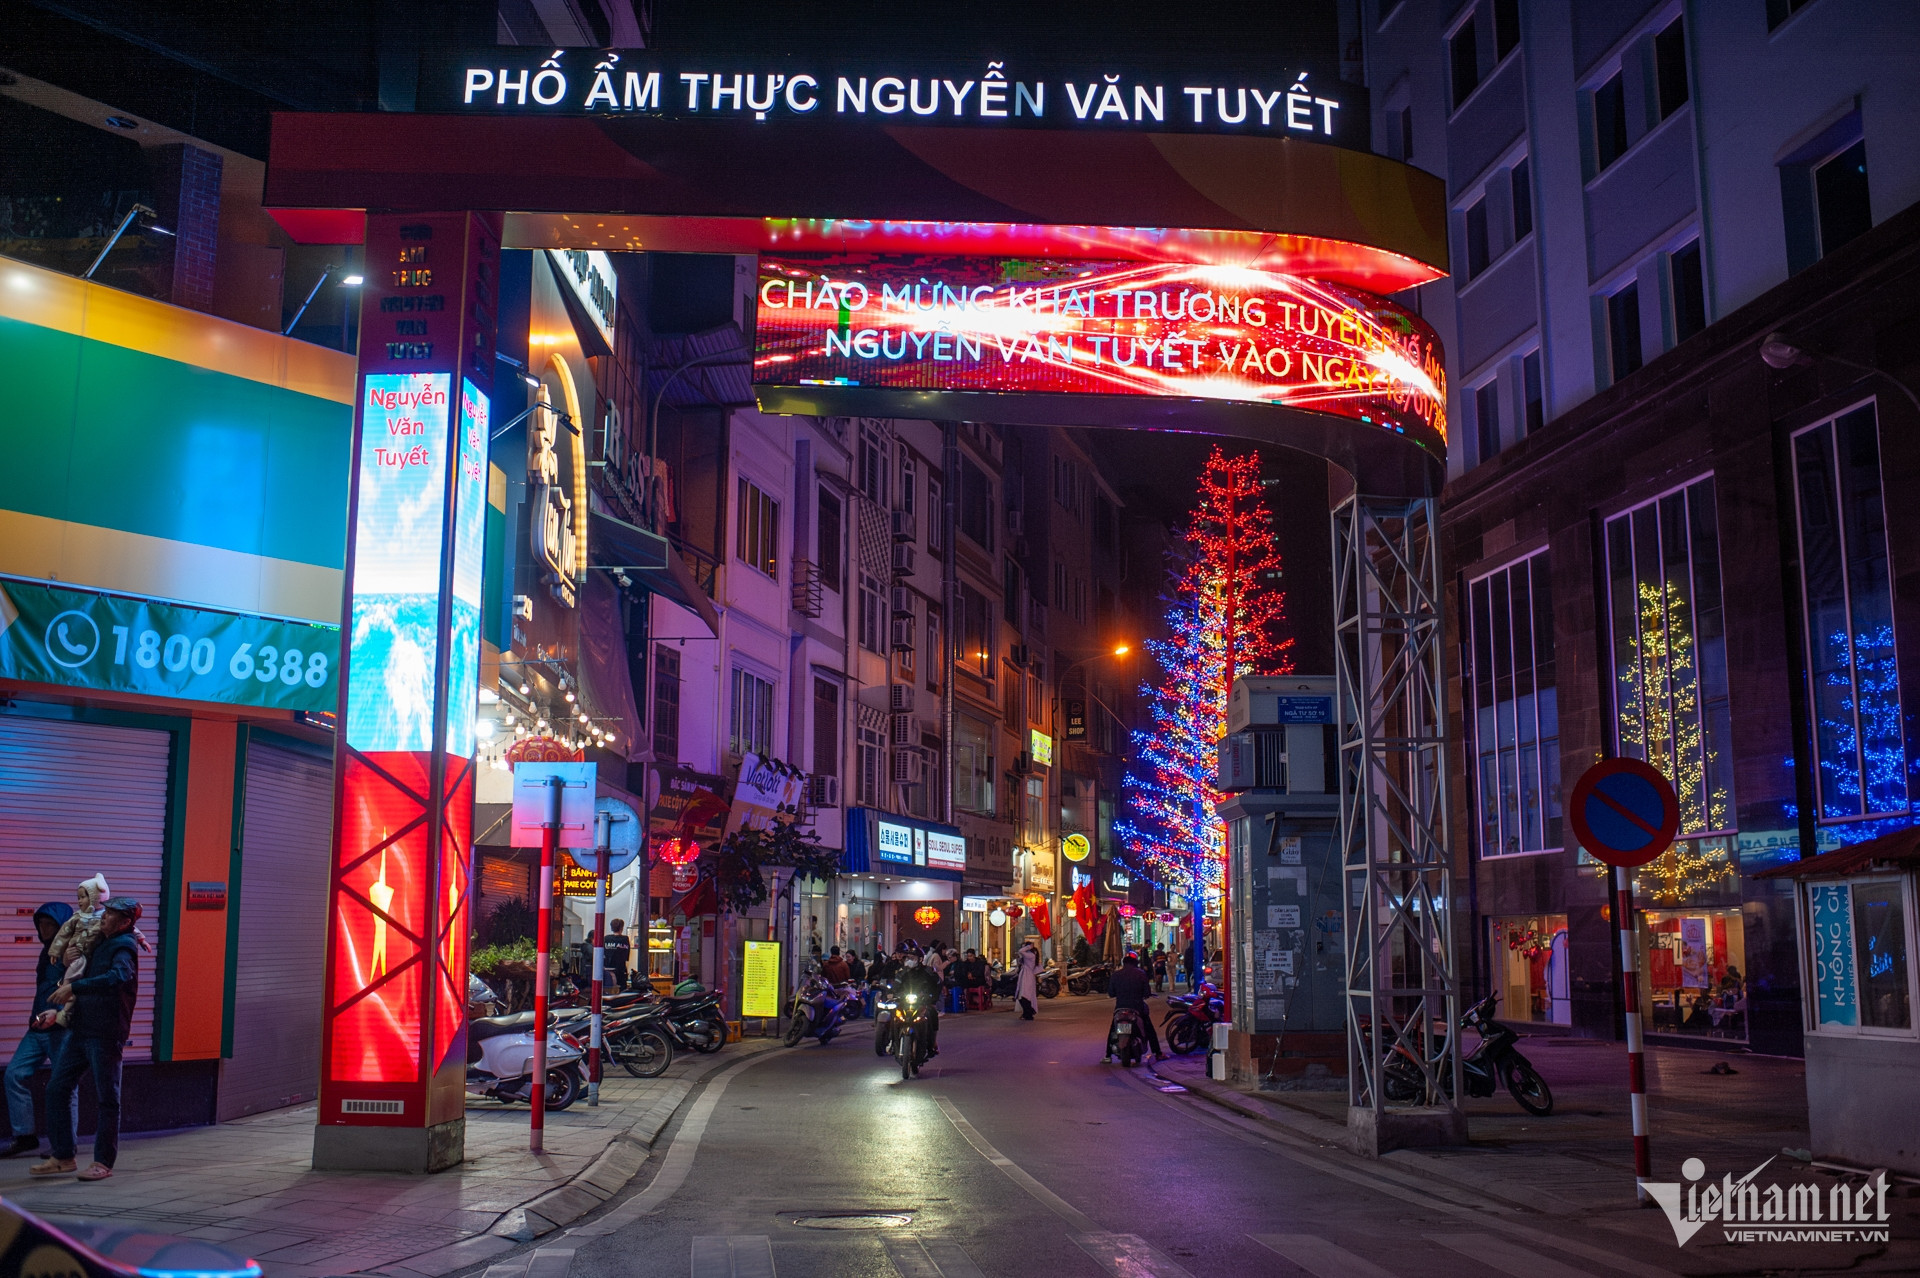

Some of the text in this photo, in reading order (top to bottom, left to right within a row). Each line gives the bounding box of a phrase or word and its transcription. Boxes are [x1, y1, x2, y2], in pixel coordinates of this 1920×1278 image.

[464, 50, 1339, 135] PHỐ ẨM THỰC NGUYỄN VĂN TUYẾT
[761, 275, 868, 311] CHÀO
[882, 277, 994, 312] MỪNG
[1009, 287, 1095, 318] KHAI
[826, 318, 982, 361] NGUYỄN
[1088, 331, 1207, 369] TUYẾT
[1219, 337, 1292, 378] VÀO
[1302, 354, 1378, 395] NGÀY
[369, 383, 446, 411] Nguyễn
[386, 418, 424, 436] Văn
[374, 444, 430, 470] Tuyết
[111, 624, 329, 689] 1800 6388
[1068, 727, 1084, 736] SHOP
[1071, 717, 1082, 725] LEE
[746, 765, 781, 794] Vietlott
[571, 867, 592, 877] BÁNH
[1829, 922, 1846, 1007] KHÔNG
